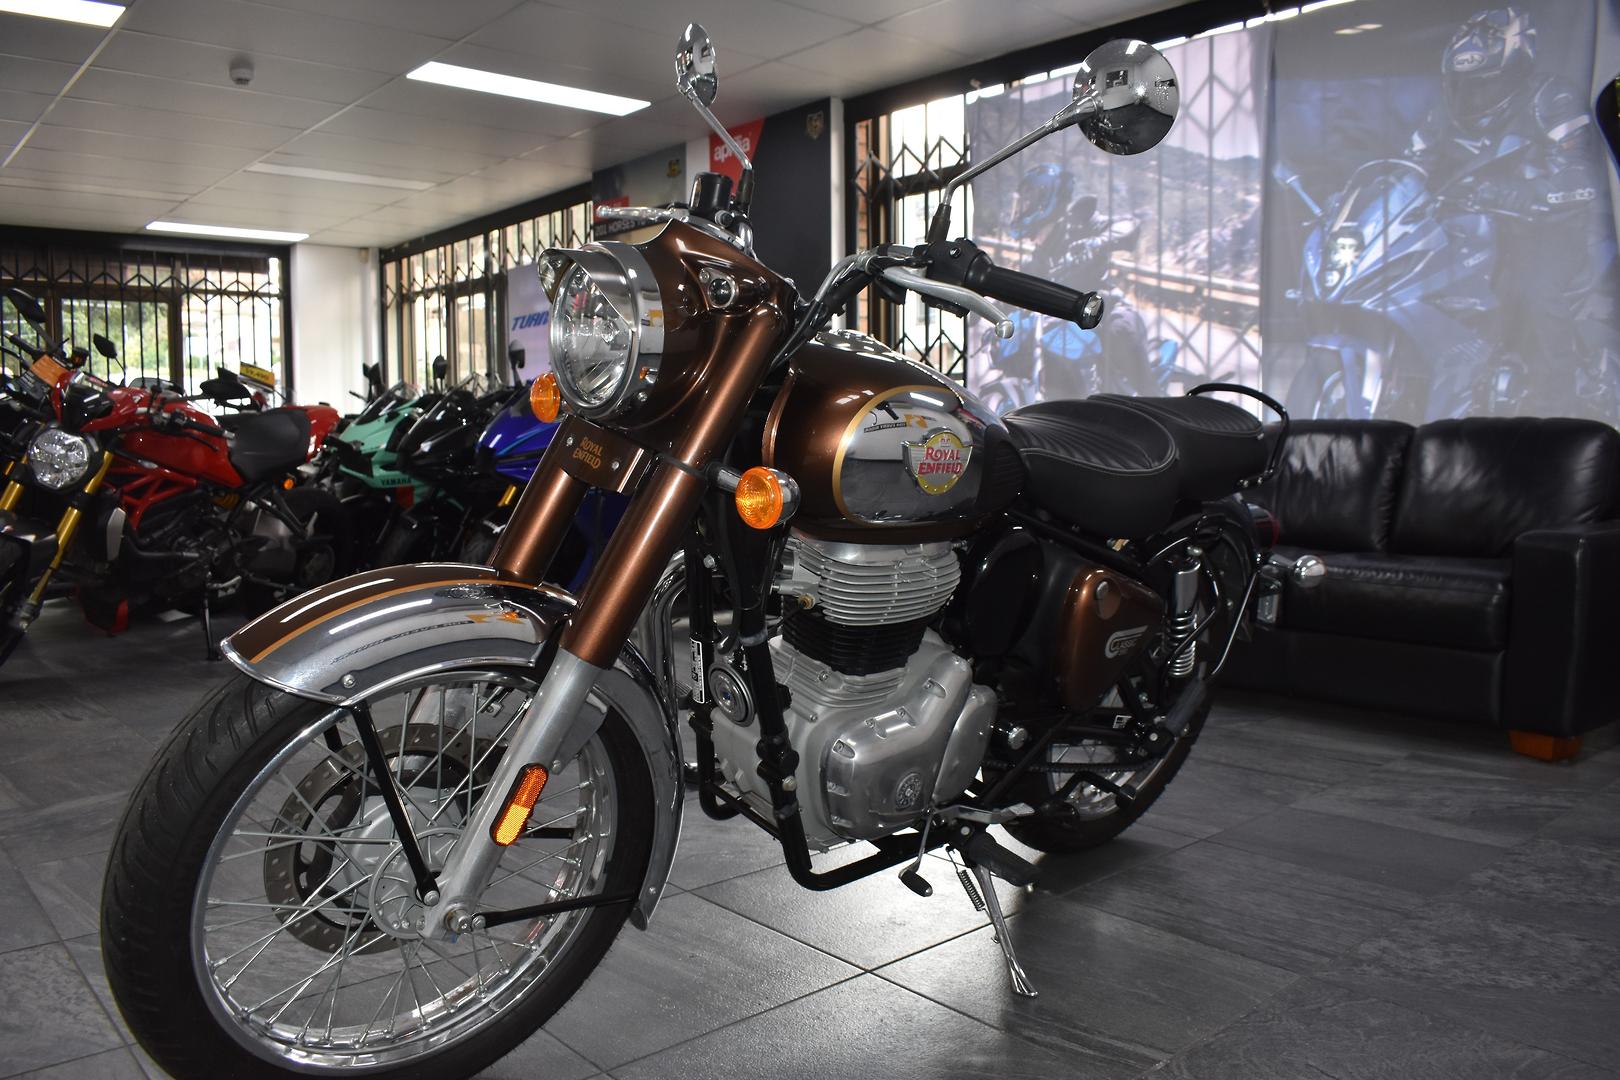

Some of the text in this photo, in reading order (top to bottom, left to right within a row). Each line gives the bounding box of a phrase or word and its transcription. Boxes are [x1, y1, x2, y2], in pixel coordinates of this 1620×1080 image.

[580, 436, 603, 457] ROYAL
[573, 448, 601, 469] ENFIELD
[924, 447, 962, 462] ROYAL
[918, 462, 964, 475] ENFIELD
[380, 477, 412, 486] YAMAHA
